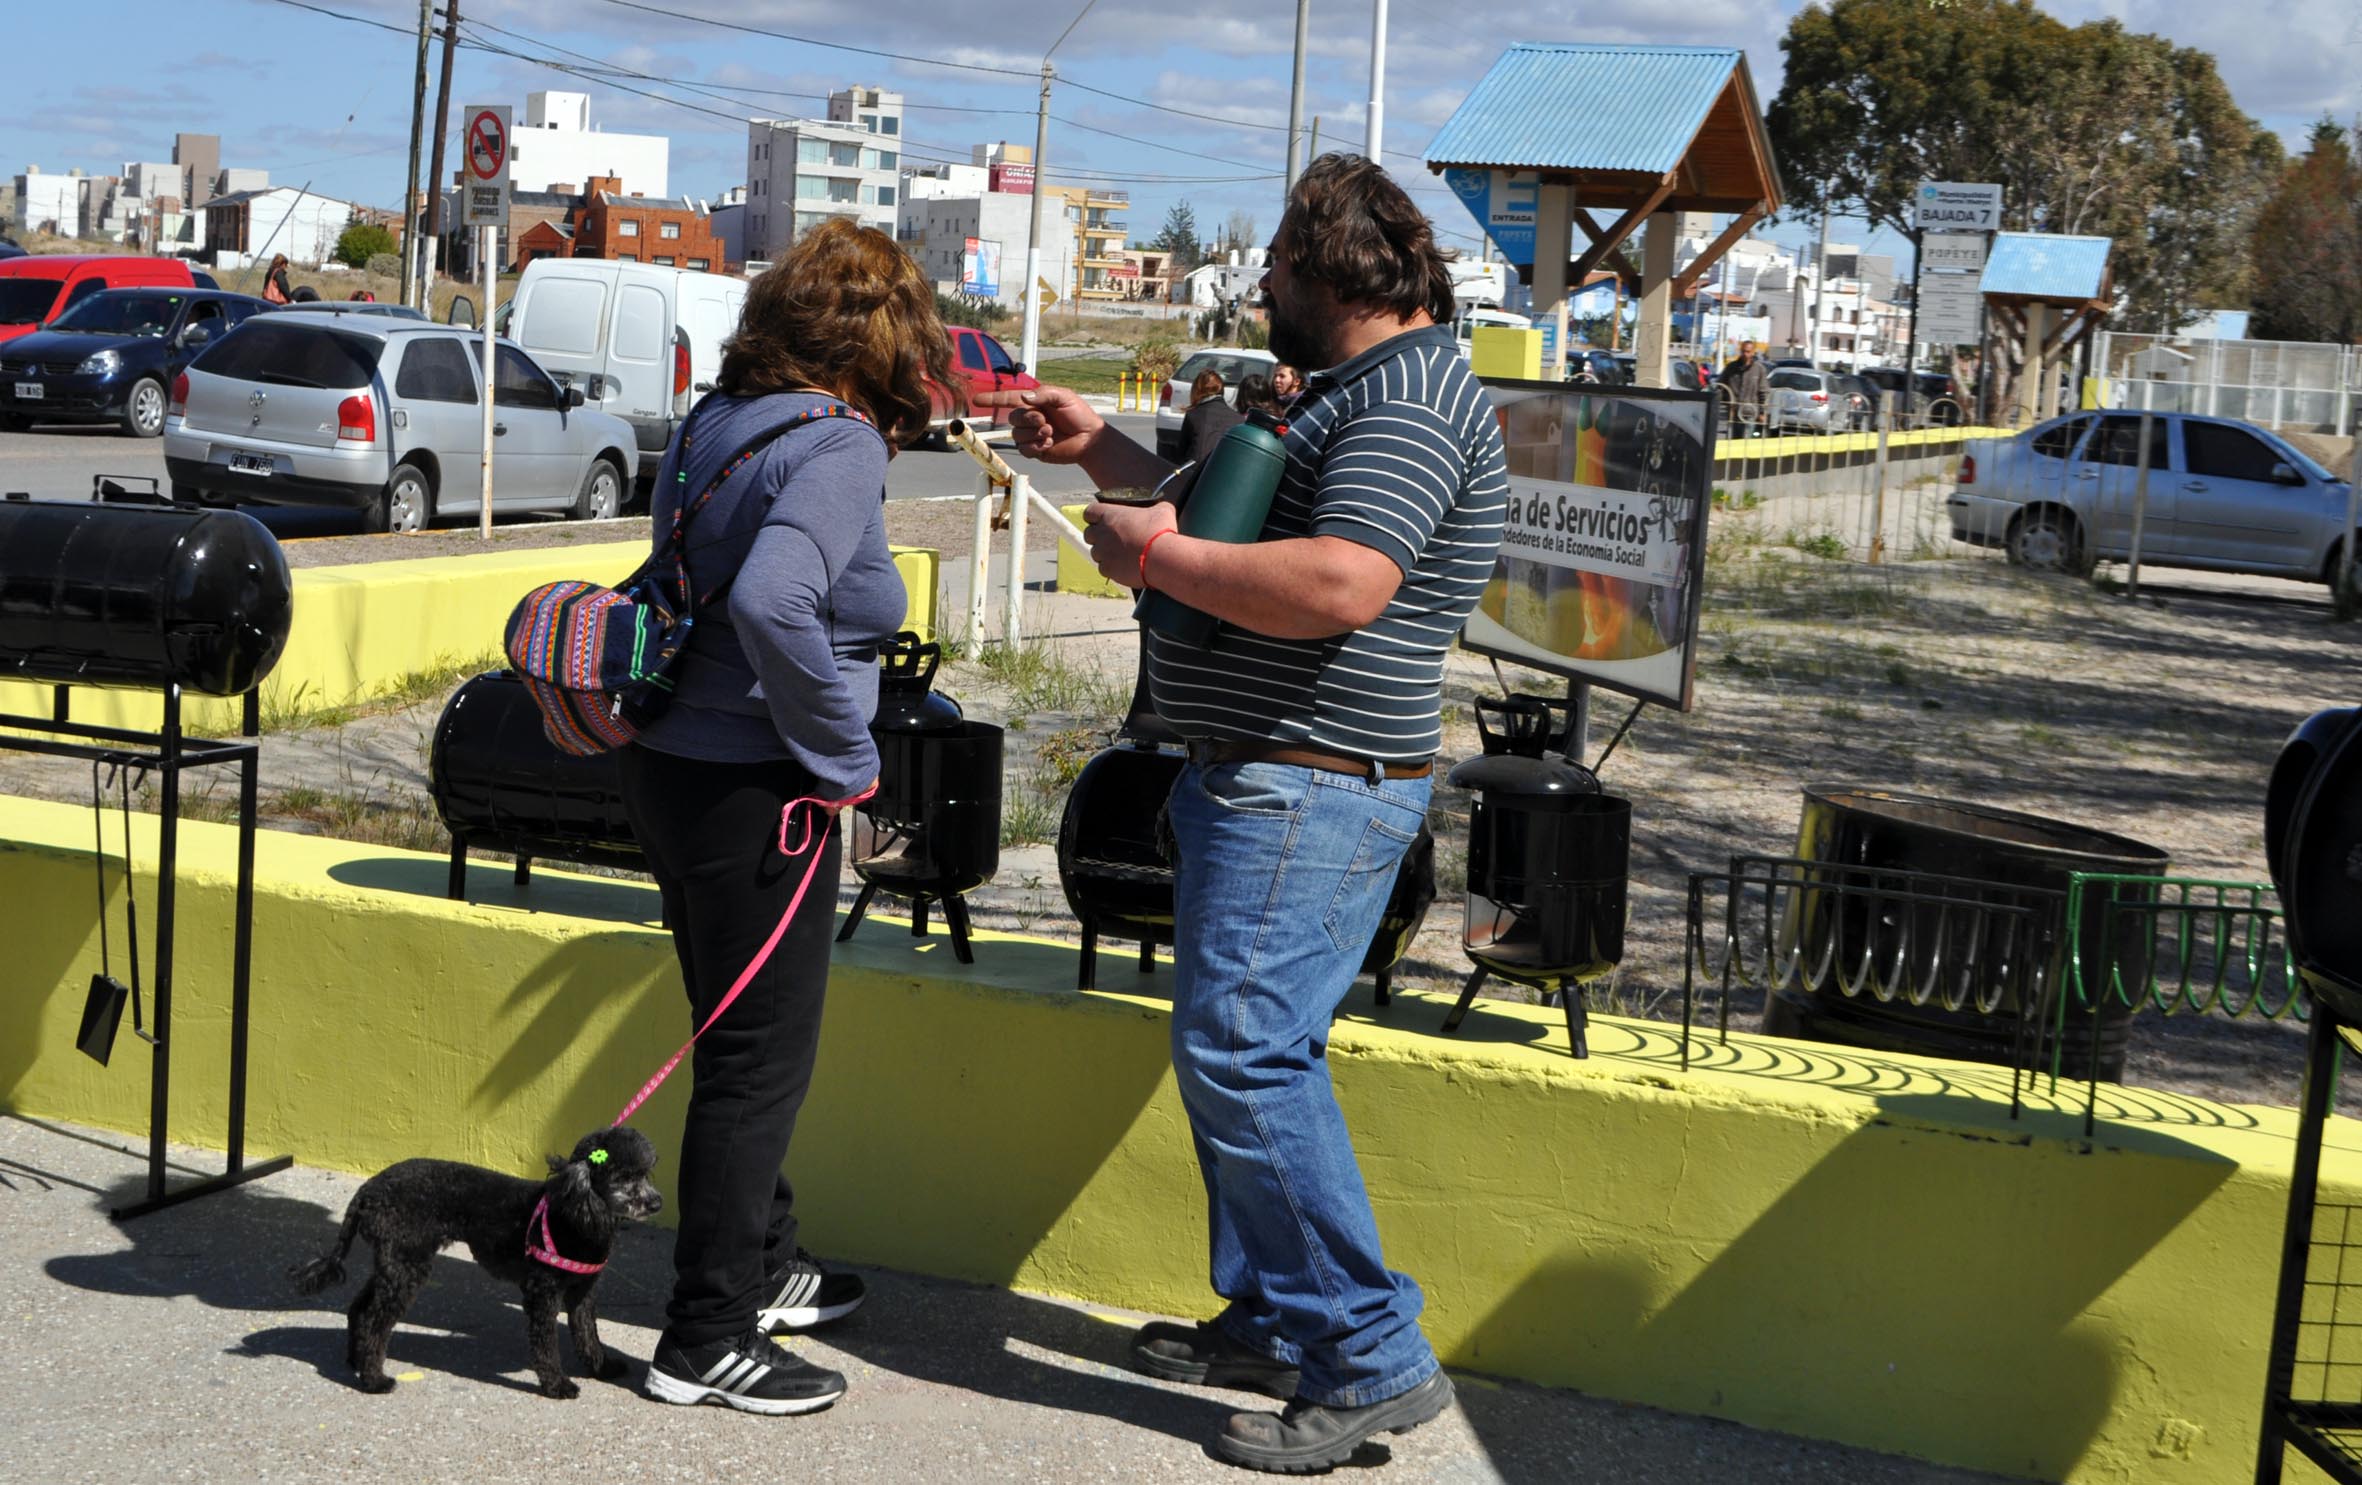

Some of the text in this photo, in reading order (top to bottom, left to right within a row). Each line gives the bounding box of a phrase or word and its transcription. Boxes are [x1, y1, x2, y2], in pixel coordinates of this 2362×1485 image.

[1492, 214, 1533, 222] ENTRADA
[1921, 209, 1991, 224] BAJADA 7
[1927, 248, 1978, 259] POPEYE
[1527, 492, 1550, 529] de
[1555, 495, 1649, 545] Servicios
[1542, 533, 1554, 551] de
[1555, 535, 1564, 552] la
[1615, 545, 1646, 568] Social
